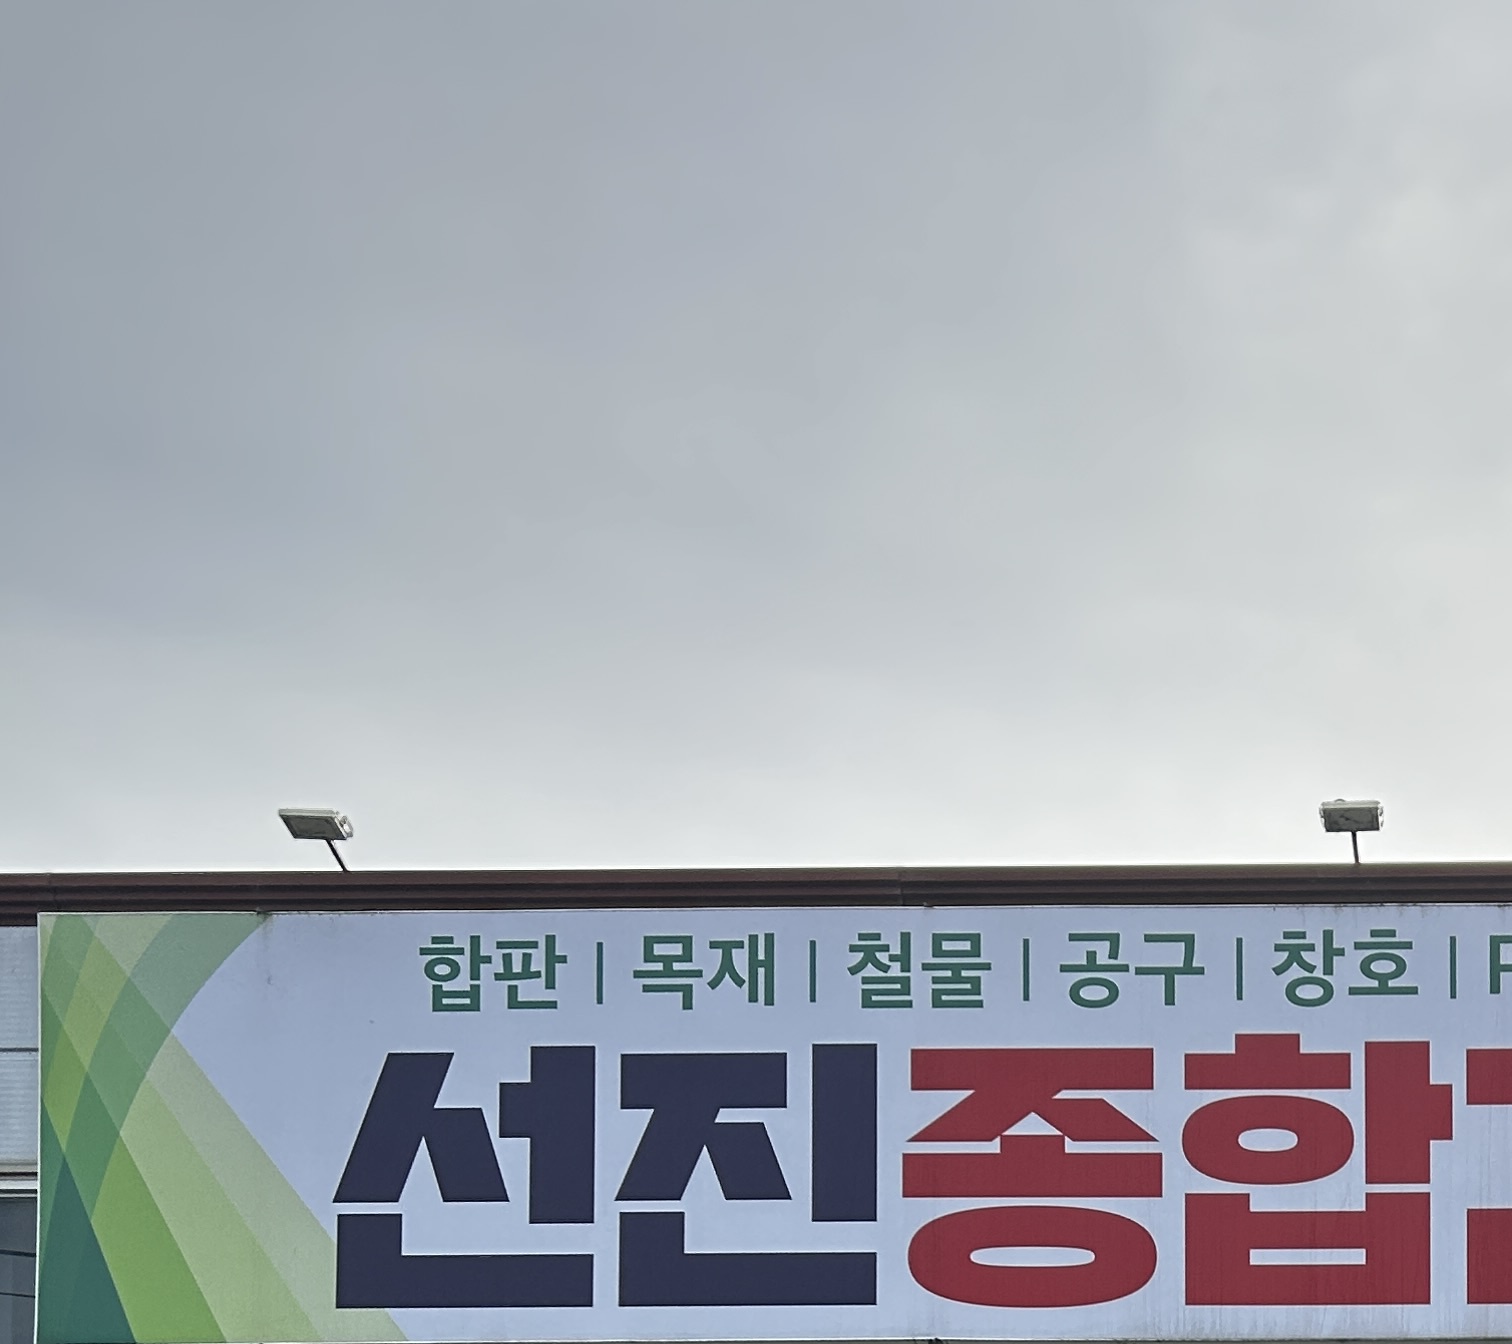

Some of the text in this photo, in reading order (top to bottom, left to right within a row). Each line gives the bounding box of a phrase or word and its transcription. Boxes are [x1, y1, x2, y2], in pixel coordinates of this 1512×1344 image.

[419, 933, 568, 1012] 합판
[632, 931, 777, 1010] 목재
[847, 930, 993, 1009] 철물
[1059, 930, 1204, 1008] 공구
[1271, 927, 1419, 1007] 창호
